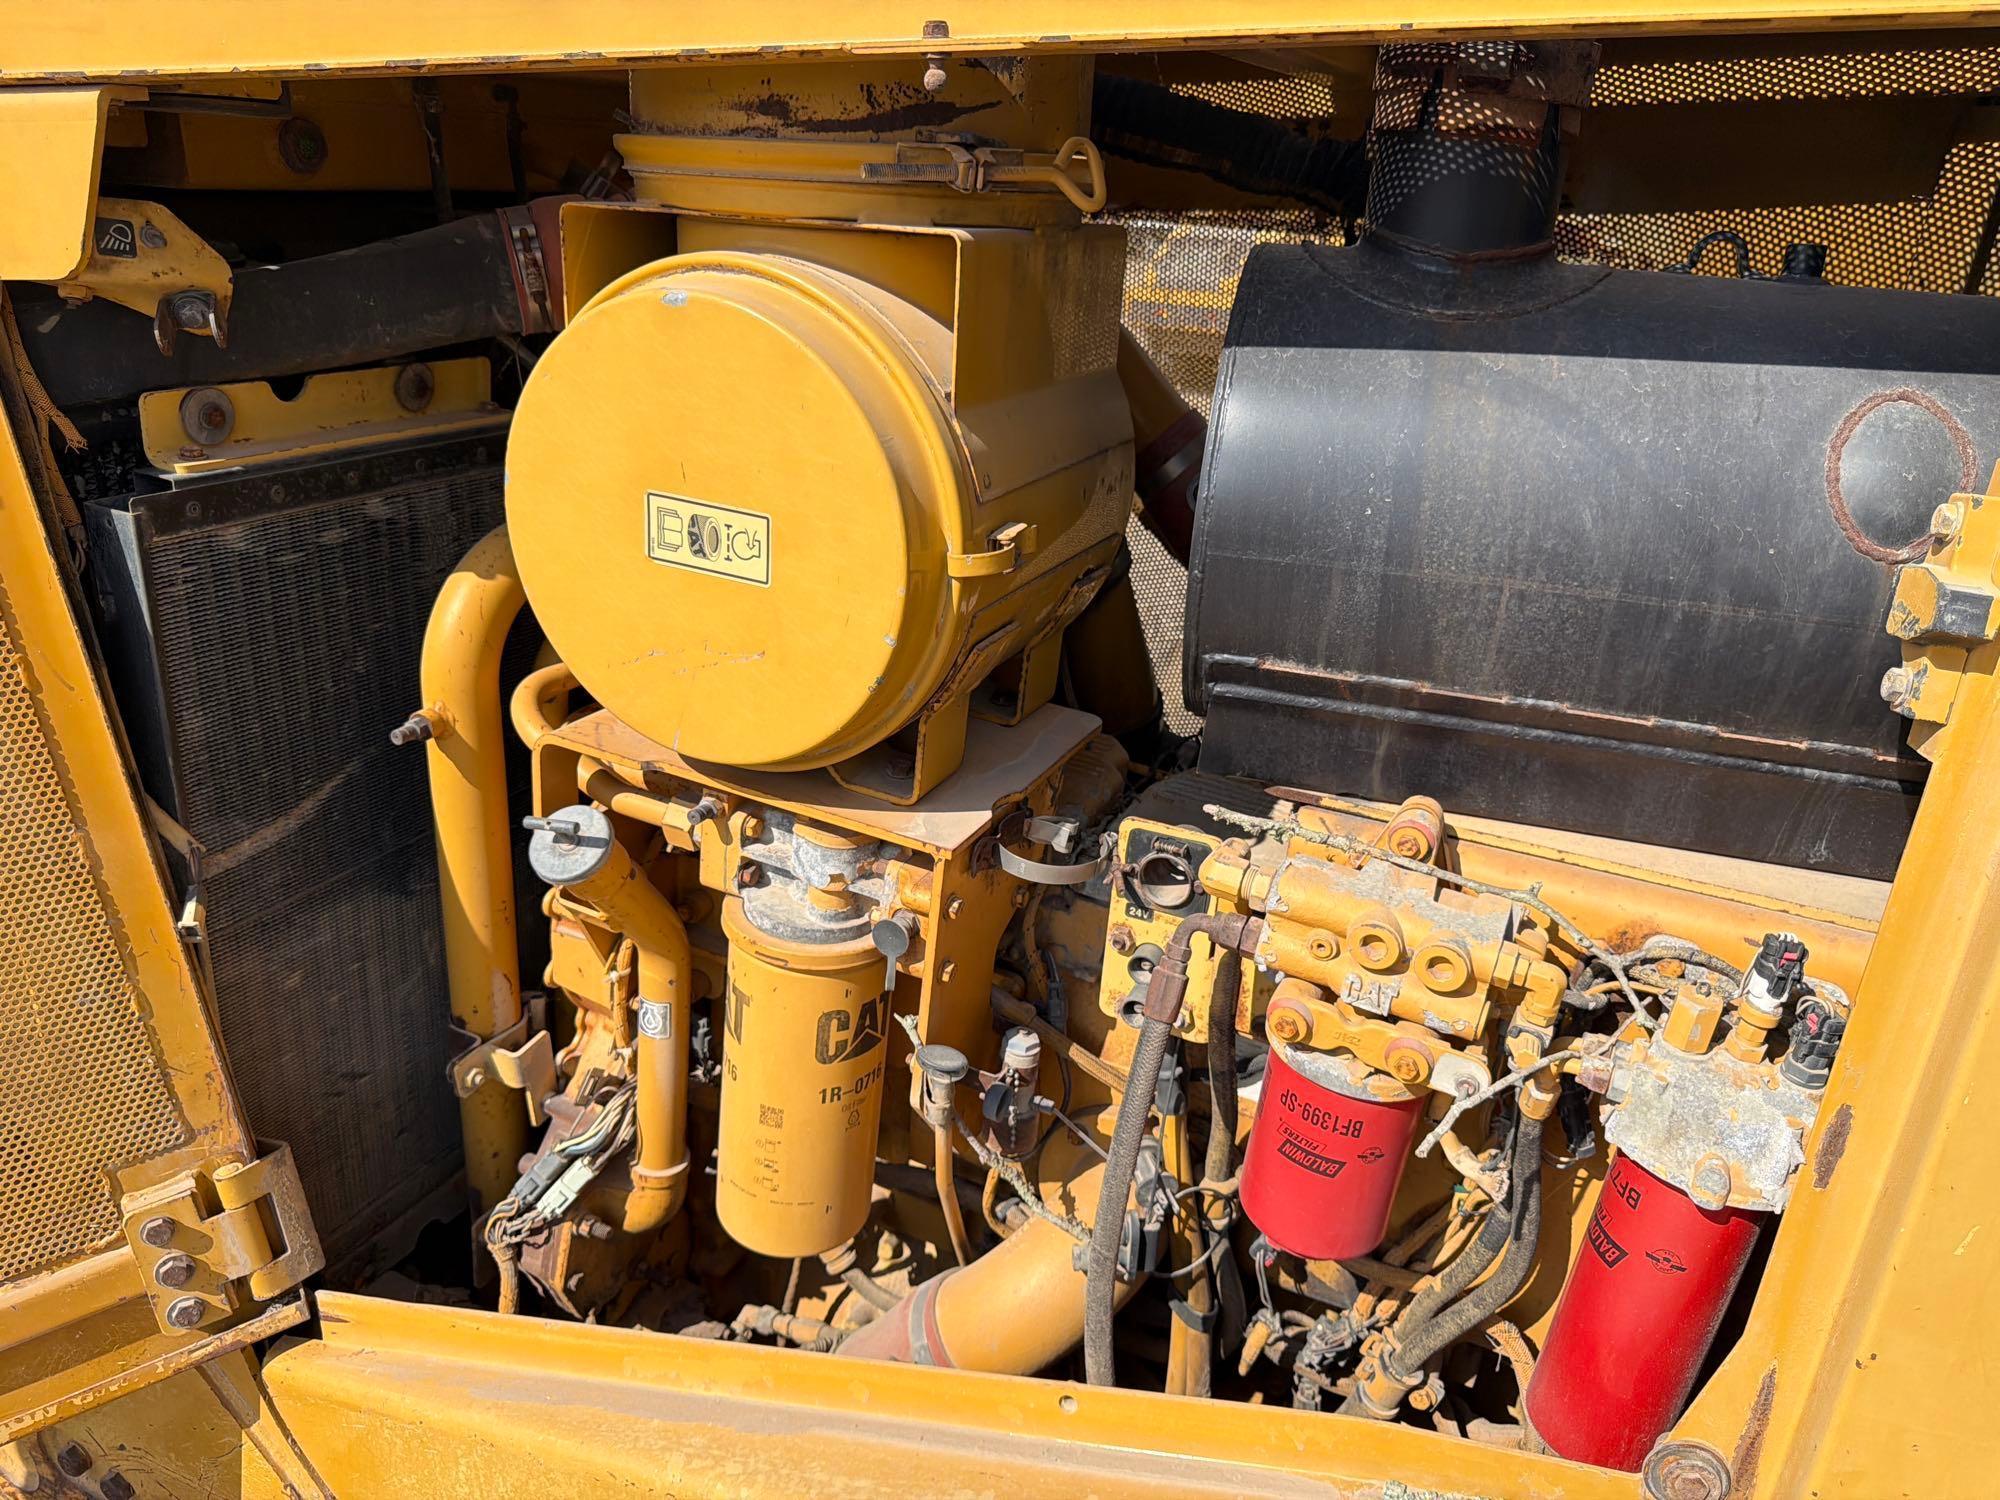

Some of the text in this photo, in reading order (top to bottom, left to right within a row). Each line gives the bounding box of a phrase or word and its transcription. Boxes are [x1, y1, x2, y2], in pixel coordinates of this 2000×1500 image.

[1128, 906, 1150, 919] 24V
[1342, 973, 1402, 1017] CAT
[819, 1061, 882, 1105] 1R-0716
[1280, 1088, 1364, 1139] BF1399-SP
[1282, 1126, 1320, 1151] FILTERS
[1282, 1141, 1341, 1175] BALDWIN
